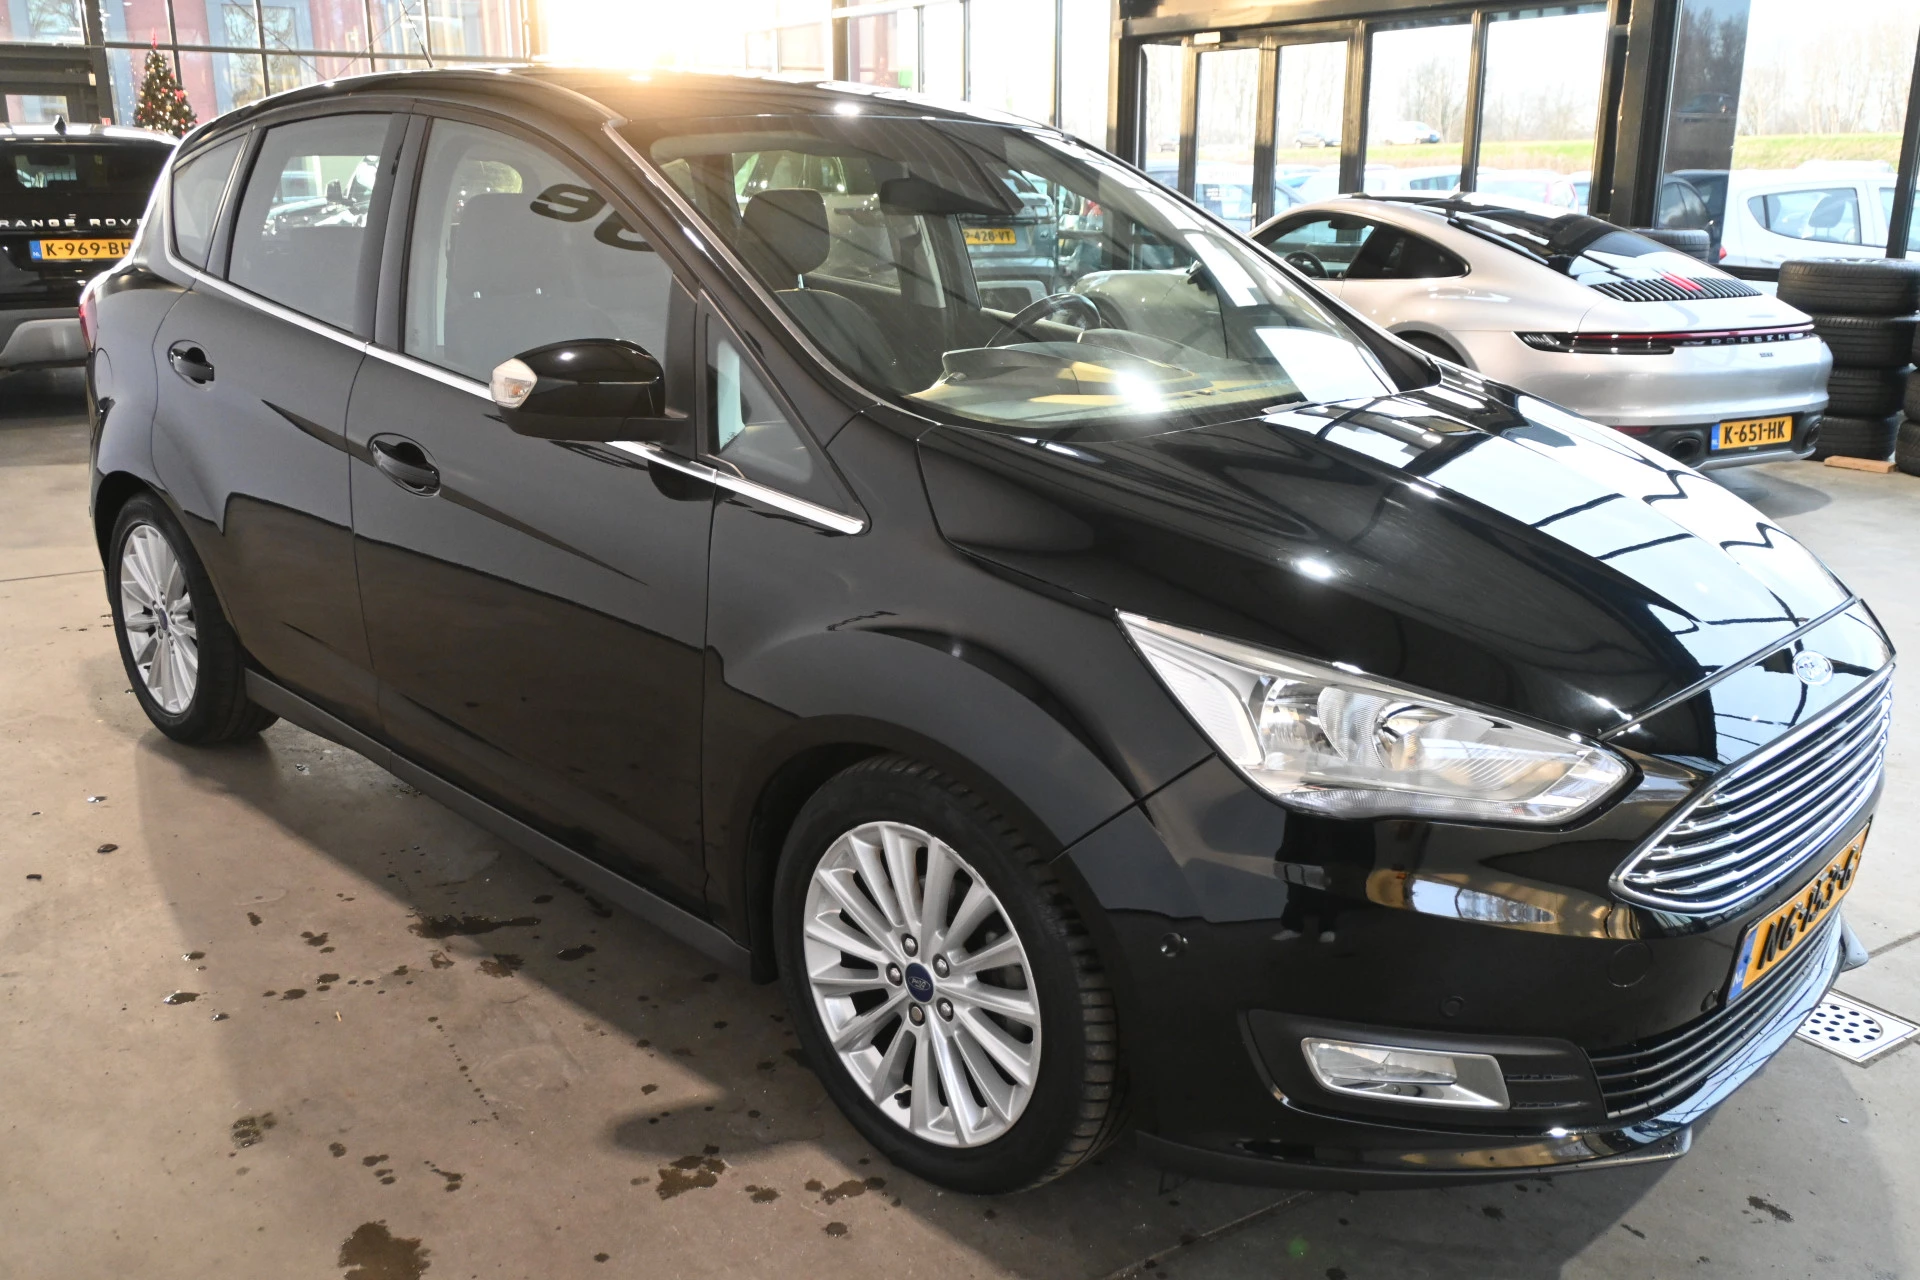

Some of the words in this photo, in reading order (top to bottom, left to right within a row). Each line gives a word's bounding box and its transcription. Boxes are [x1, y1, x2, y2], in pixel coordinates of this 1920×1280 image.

[0, 218, 76, 228] RANGE
[45, 242, 131, 256] K-969-BH
[1724, 420, 1786, 445] K-651-HK
